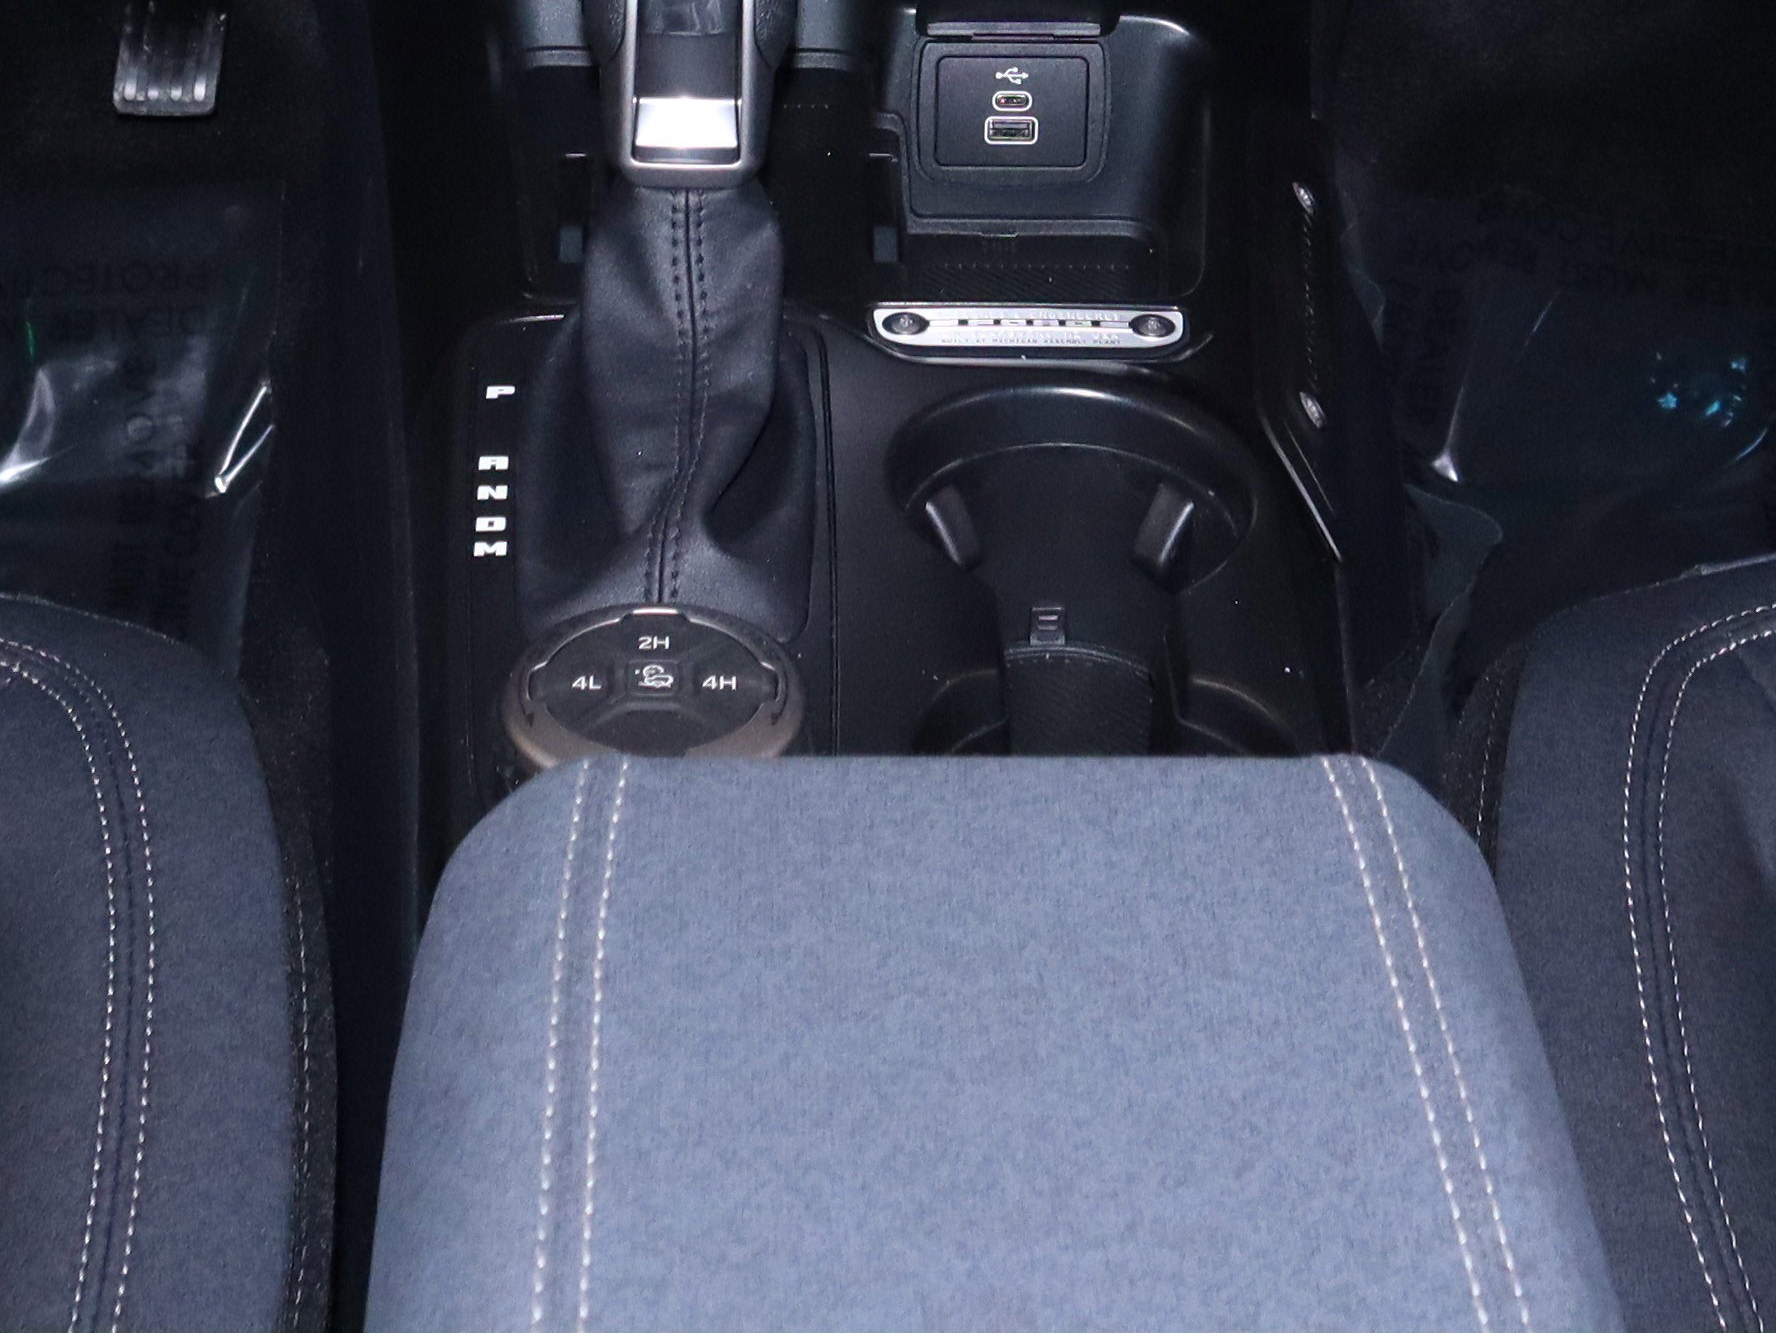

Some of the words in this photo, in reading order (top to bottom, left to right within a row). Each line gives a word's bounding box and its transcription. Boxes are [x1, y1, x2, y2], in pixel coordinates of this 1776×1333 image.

[486, 384, 516, 399] P
[476, 484, 508, 500] N
[475, 516, 507, 532] D
[473, 541, 508, 557] M
[638, 636, 670, 650] 2H
[571, 676, 602, 690] 4L
[702, 676, 737, 691] 4H
